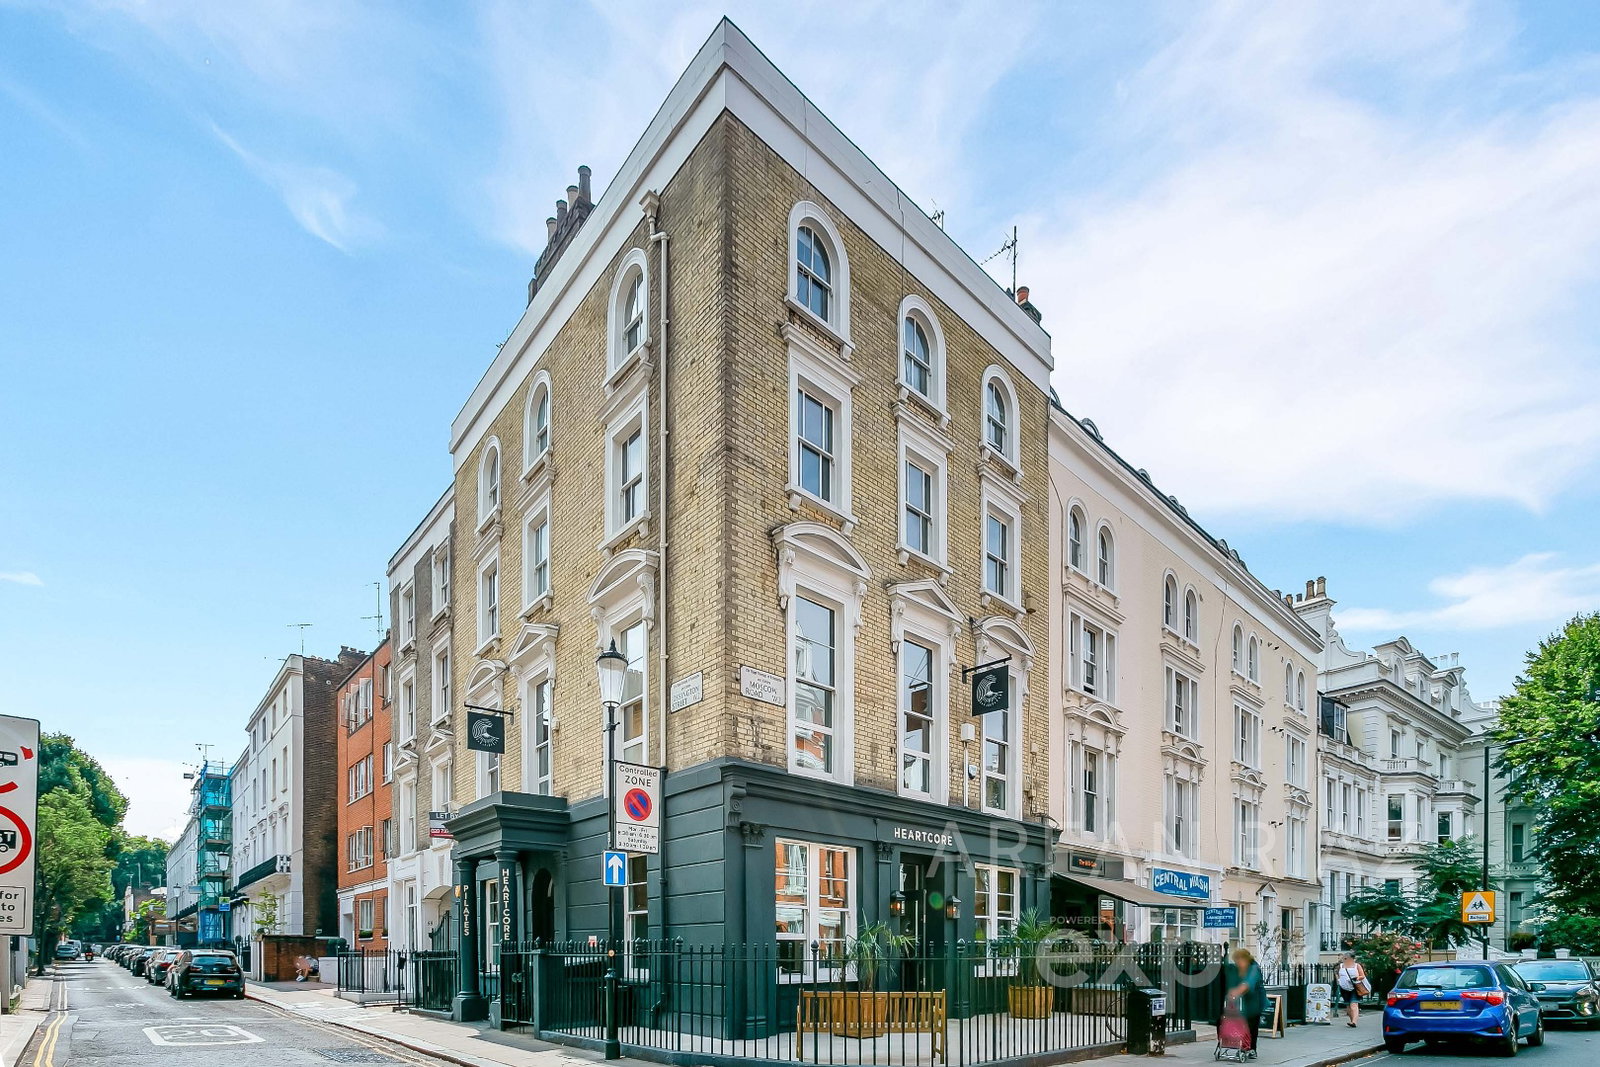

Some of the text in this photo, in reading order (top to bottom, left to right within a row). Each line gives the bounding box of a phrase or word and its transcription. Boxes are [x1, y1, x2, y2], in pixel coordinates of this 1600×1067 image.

[745, 686, 763, 699] ROAD
[749, 680, 777, 695] MOSCOW
[619, 765, 658, 778] Controlled
[625, 775, 652, 788] ZONE
[894, 827, 953, 847] HEARTCORE
[1154, 871, 1188, 891] CENTRAL
[1189, 875, 1209, 894] WASH
[502, 868, 511, 941] HEARTCORE
[161, 1028, 239, 1040] 20
